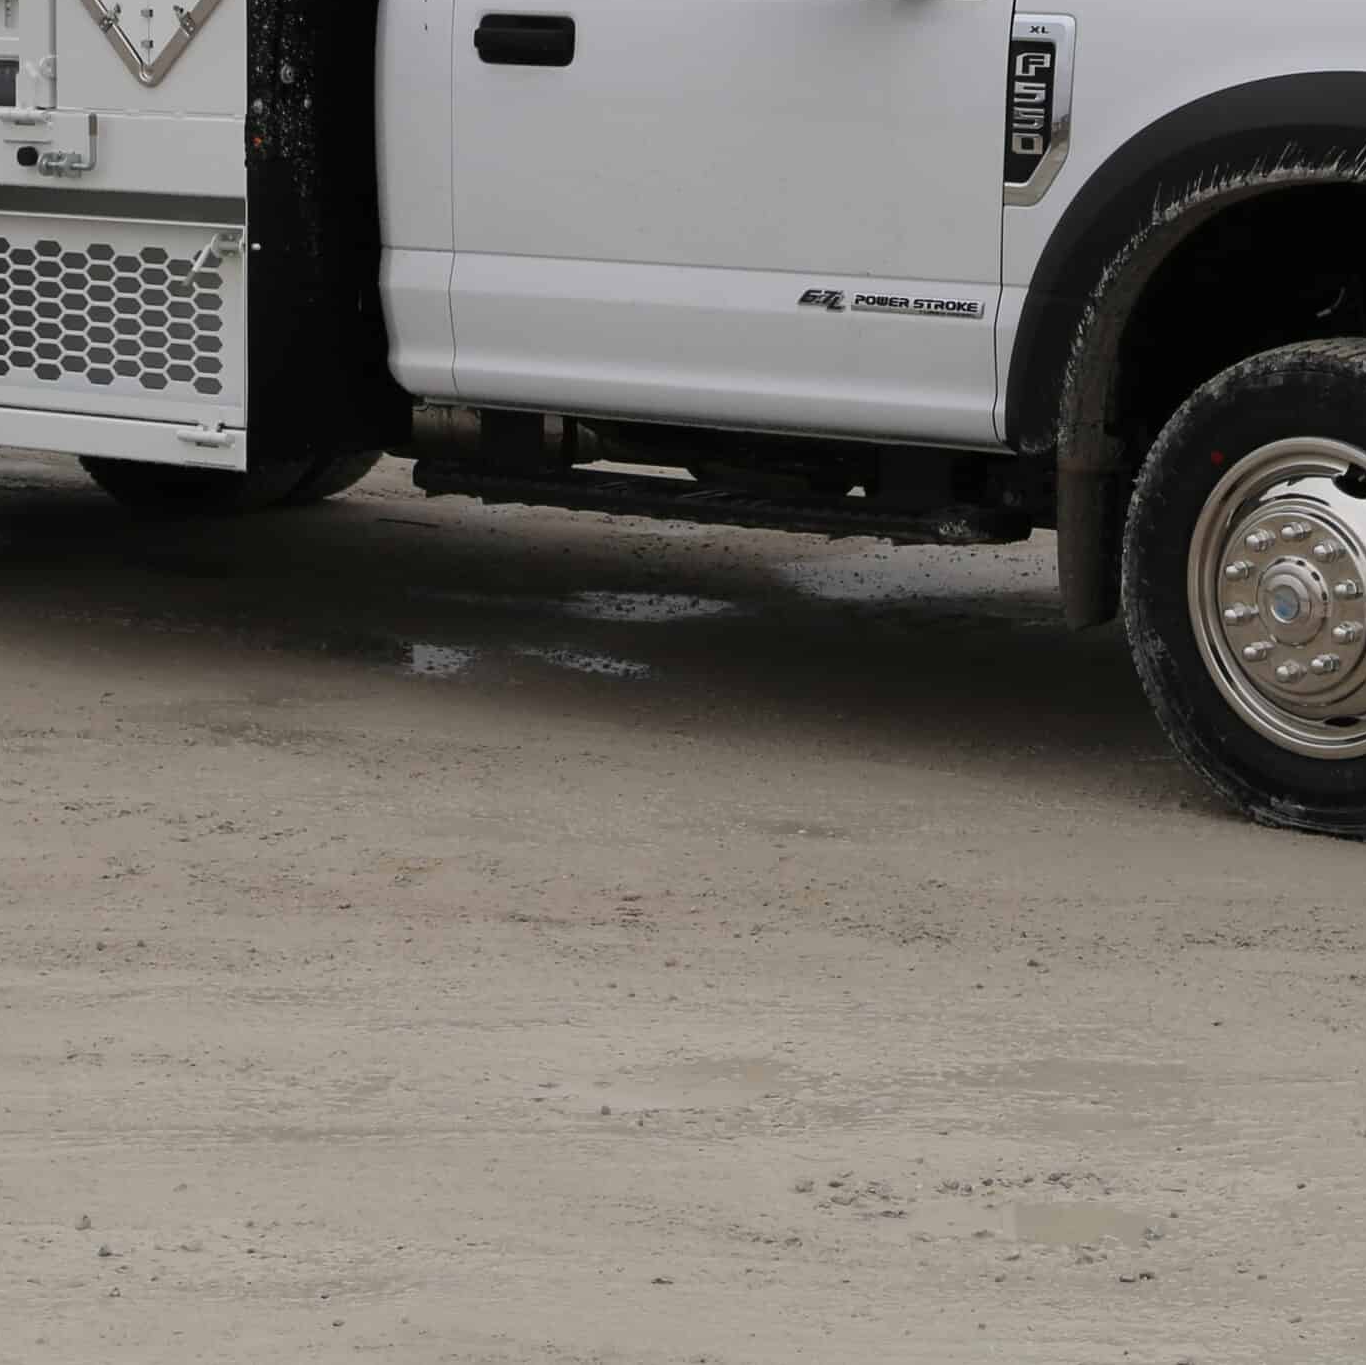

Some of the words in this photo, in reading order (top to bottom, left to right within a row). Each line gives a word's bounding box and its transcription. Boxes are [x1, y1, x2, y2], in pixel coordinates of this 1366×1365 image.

[1029, 25, 1049, 34] XL
[1011, 52, 1052, 155] F550
[854, 294, 910, 309] POWER
[913, 298, 978, 313] STROKE
